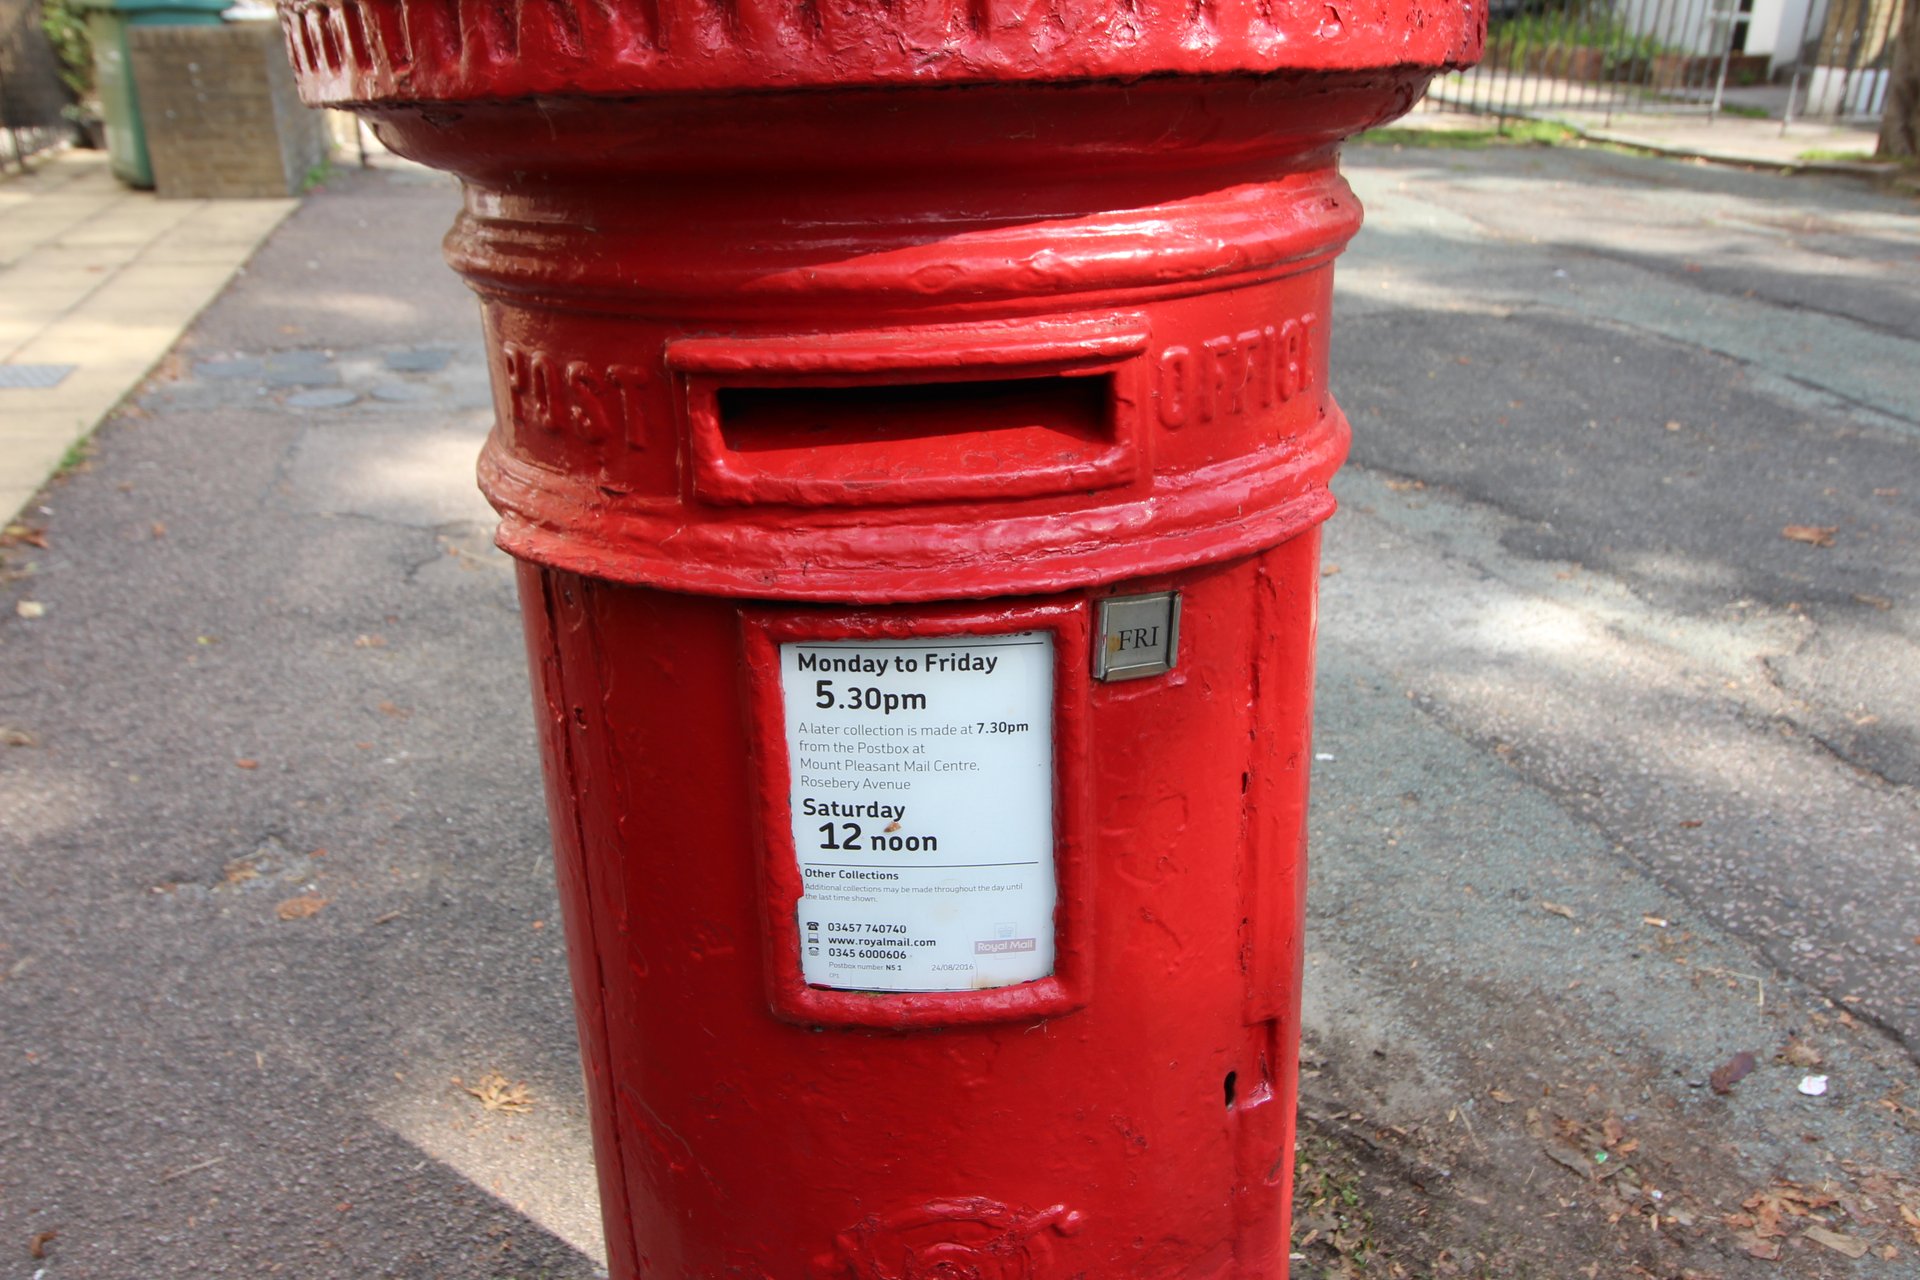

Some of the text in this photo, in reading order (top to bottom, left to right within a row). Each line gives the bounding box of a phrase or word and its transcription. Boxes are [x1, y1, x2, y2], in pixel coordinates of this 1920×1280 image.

[503, 312, 1318, 452] POST OFFICE
[1117, 626, 1160, 652] FRI
[798, 652, 998, 677] Monday to Friday
[815, 680, 926, 715] 5.30pm
[798, 721, 1029, 736] A later collection is made at 7.30pm
[799, 740, 925, 754] from the Postbox at
[800, 758, 842, 771] Mount
[845, 759, 900, 772] Pleasant
[904, 760, 930, 772] Mail
[801, 775, 911, 791] Rosebery Avenue
[803, 798, 906, 822] Saturday
[818, 821, 938, 851] 12 noon
[805, 868, 899, 880] Other Collections
[805, 883, 841, 892] Additional
[843, 885, 882, 893] collections
[901, 885, 910, 893] be
[912, 886, 933, 894] made
[934, 886, 977, 894] throughout
[978, 884, 990, 892] the
[992, 884, 1005, 892] day
[1006, 883, 1023, 891] until
[819, 893, 832, 901] last
[852, 894, 878, 902] shown.
[828, 922, 907, 934] 03457 740740
[828, 937, 936, 948] www.royalmail.com
[977, 940, 1033, 953] Royal Mail
[829, 948, 907, 960] 0345 6000606
[829, 961, 856, 970] Postbox
[858, 963, 883, 971] number
[931, 963, 974, 972] 24/08/2016
